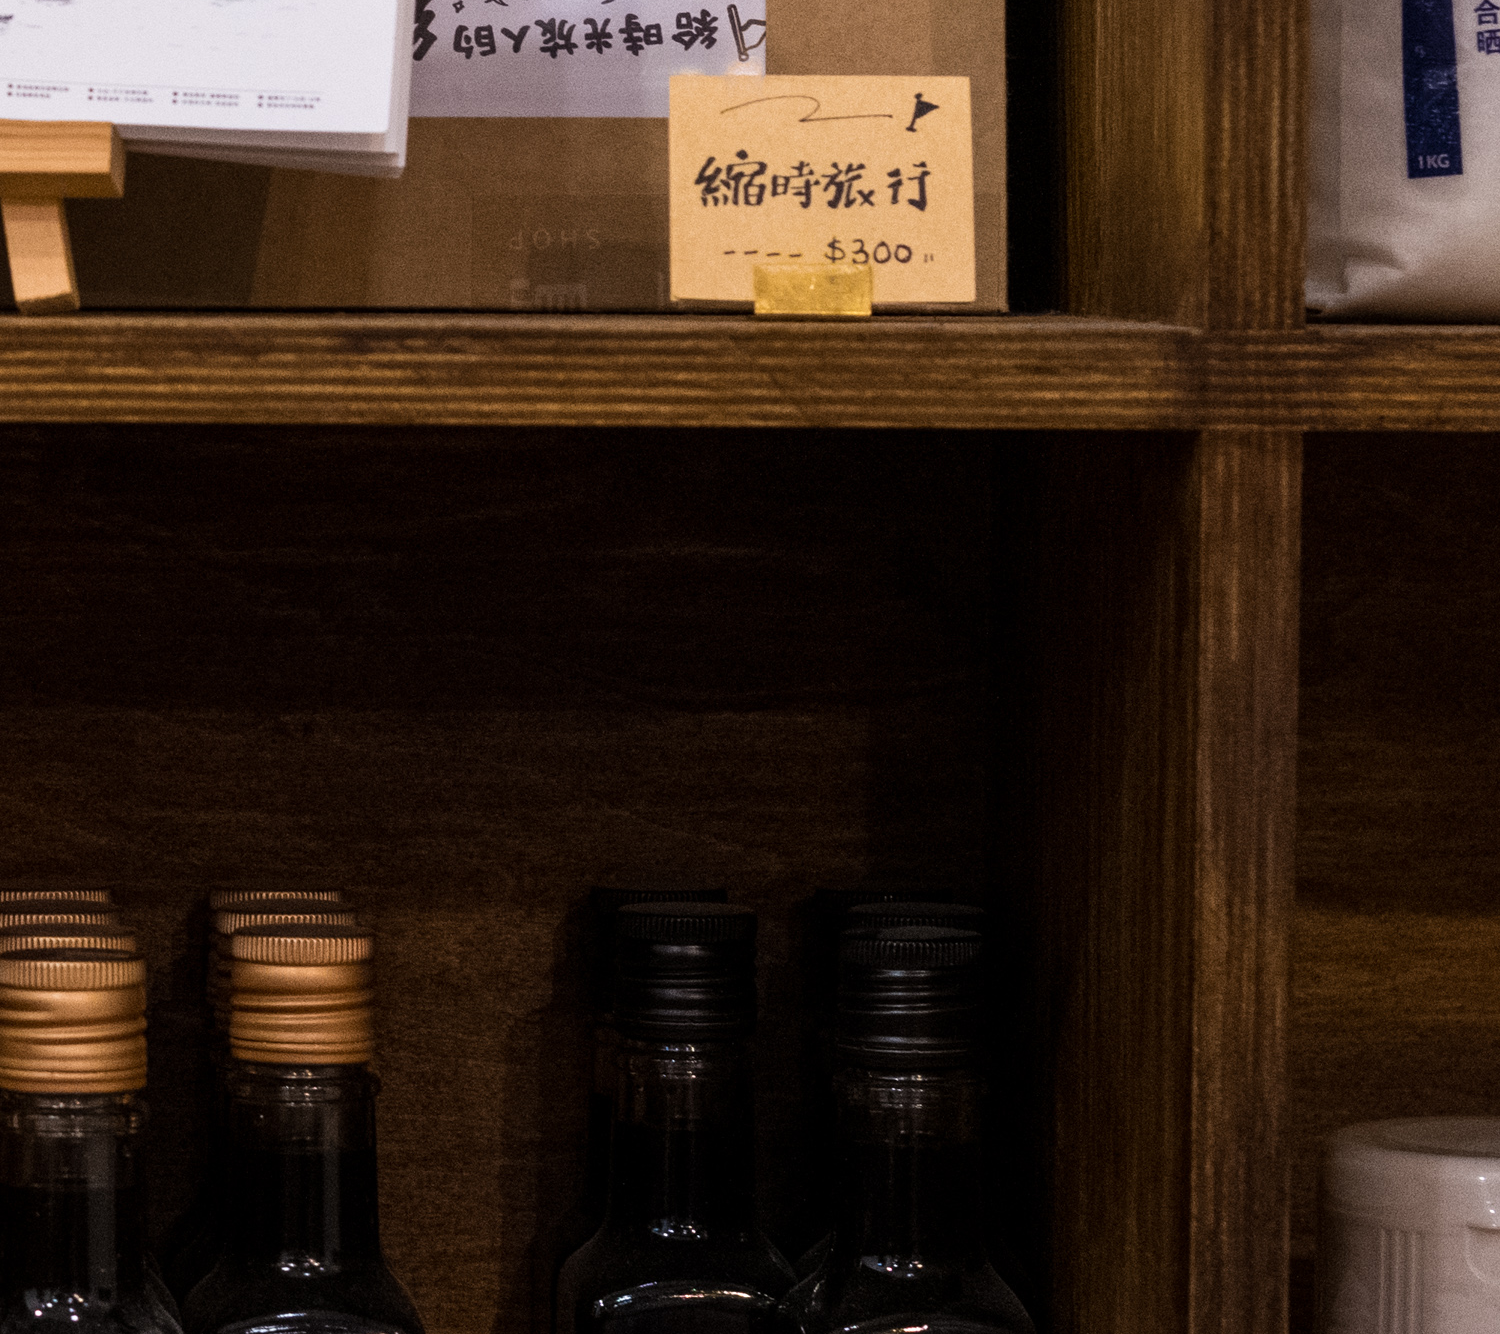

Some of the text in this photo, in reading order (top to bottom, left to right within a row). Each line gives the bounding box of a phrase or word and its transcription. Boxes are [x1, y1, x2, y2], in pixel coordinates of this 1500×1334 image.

[1416, 152, 1450, 170] 1KG
[694, 149, 931, 215] 縮時旅行
[823, 237, 914, 267] $300
